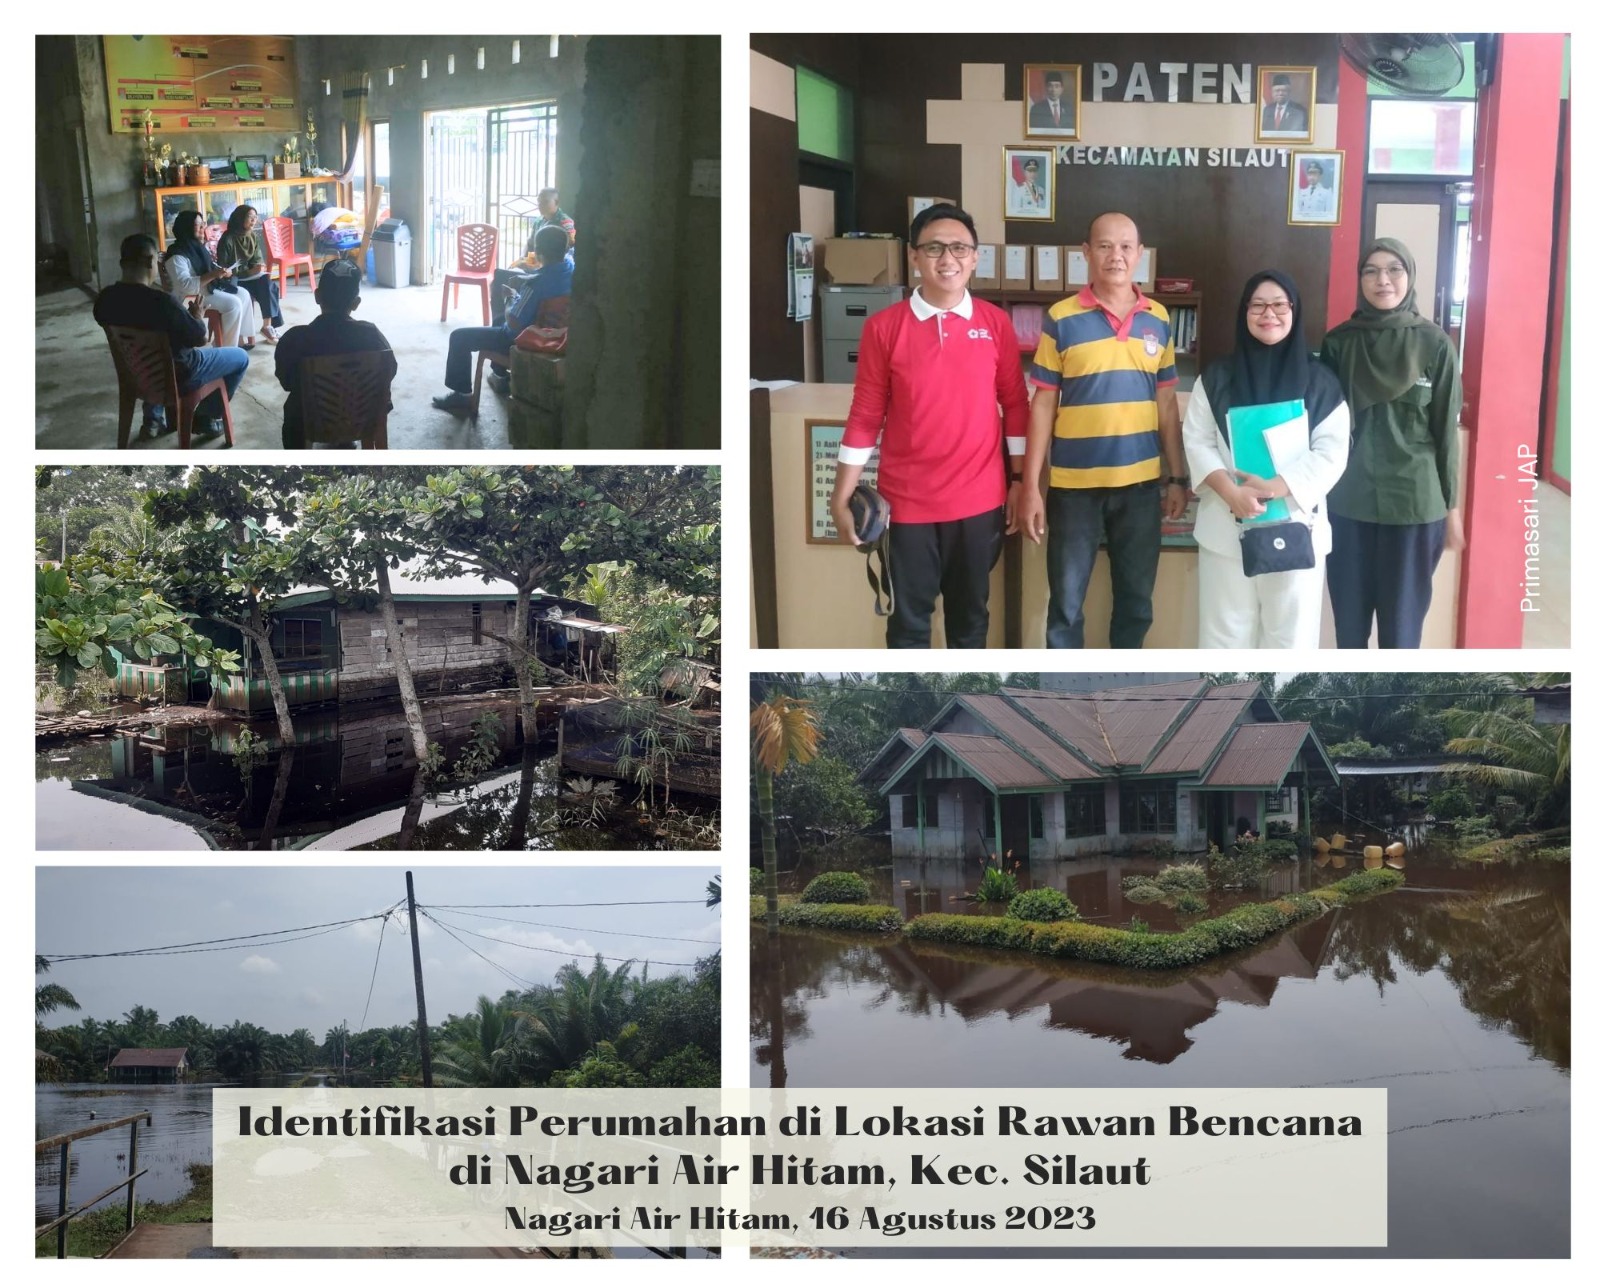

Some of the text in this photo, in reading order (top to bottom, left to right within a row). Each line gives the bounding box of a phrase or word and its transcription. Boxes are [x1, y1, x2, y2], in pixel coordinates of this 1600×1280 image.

[1092, 61, 1253, 104] PATEN
[1056, 145, 1291, 168] KECAMATAN SILAUT
